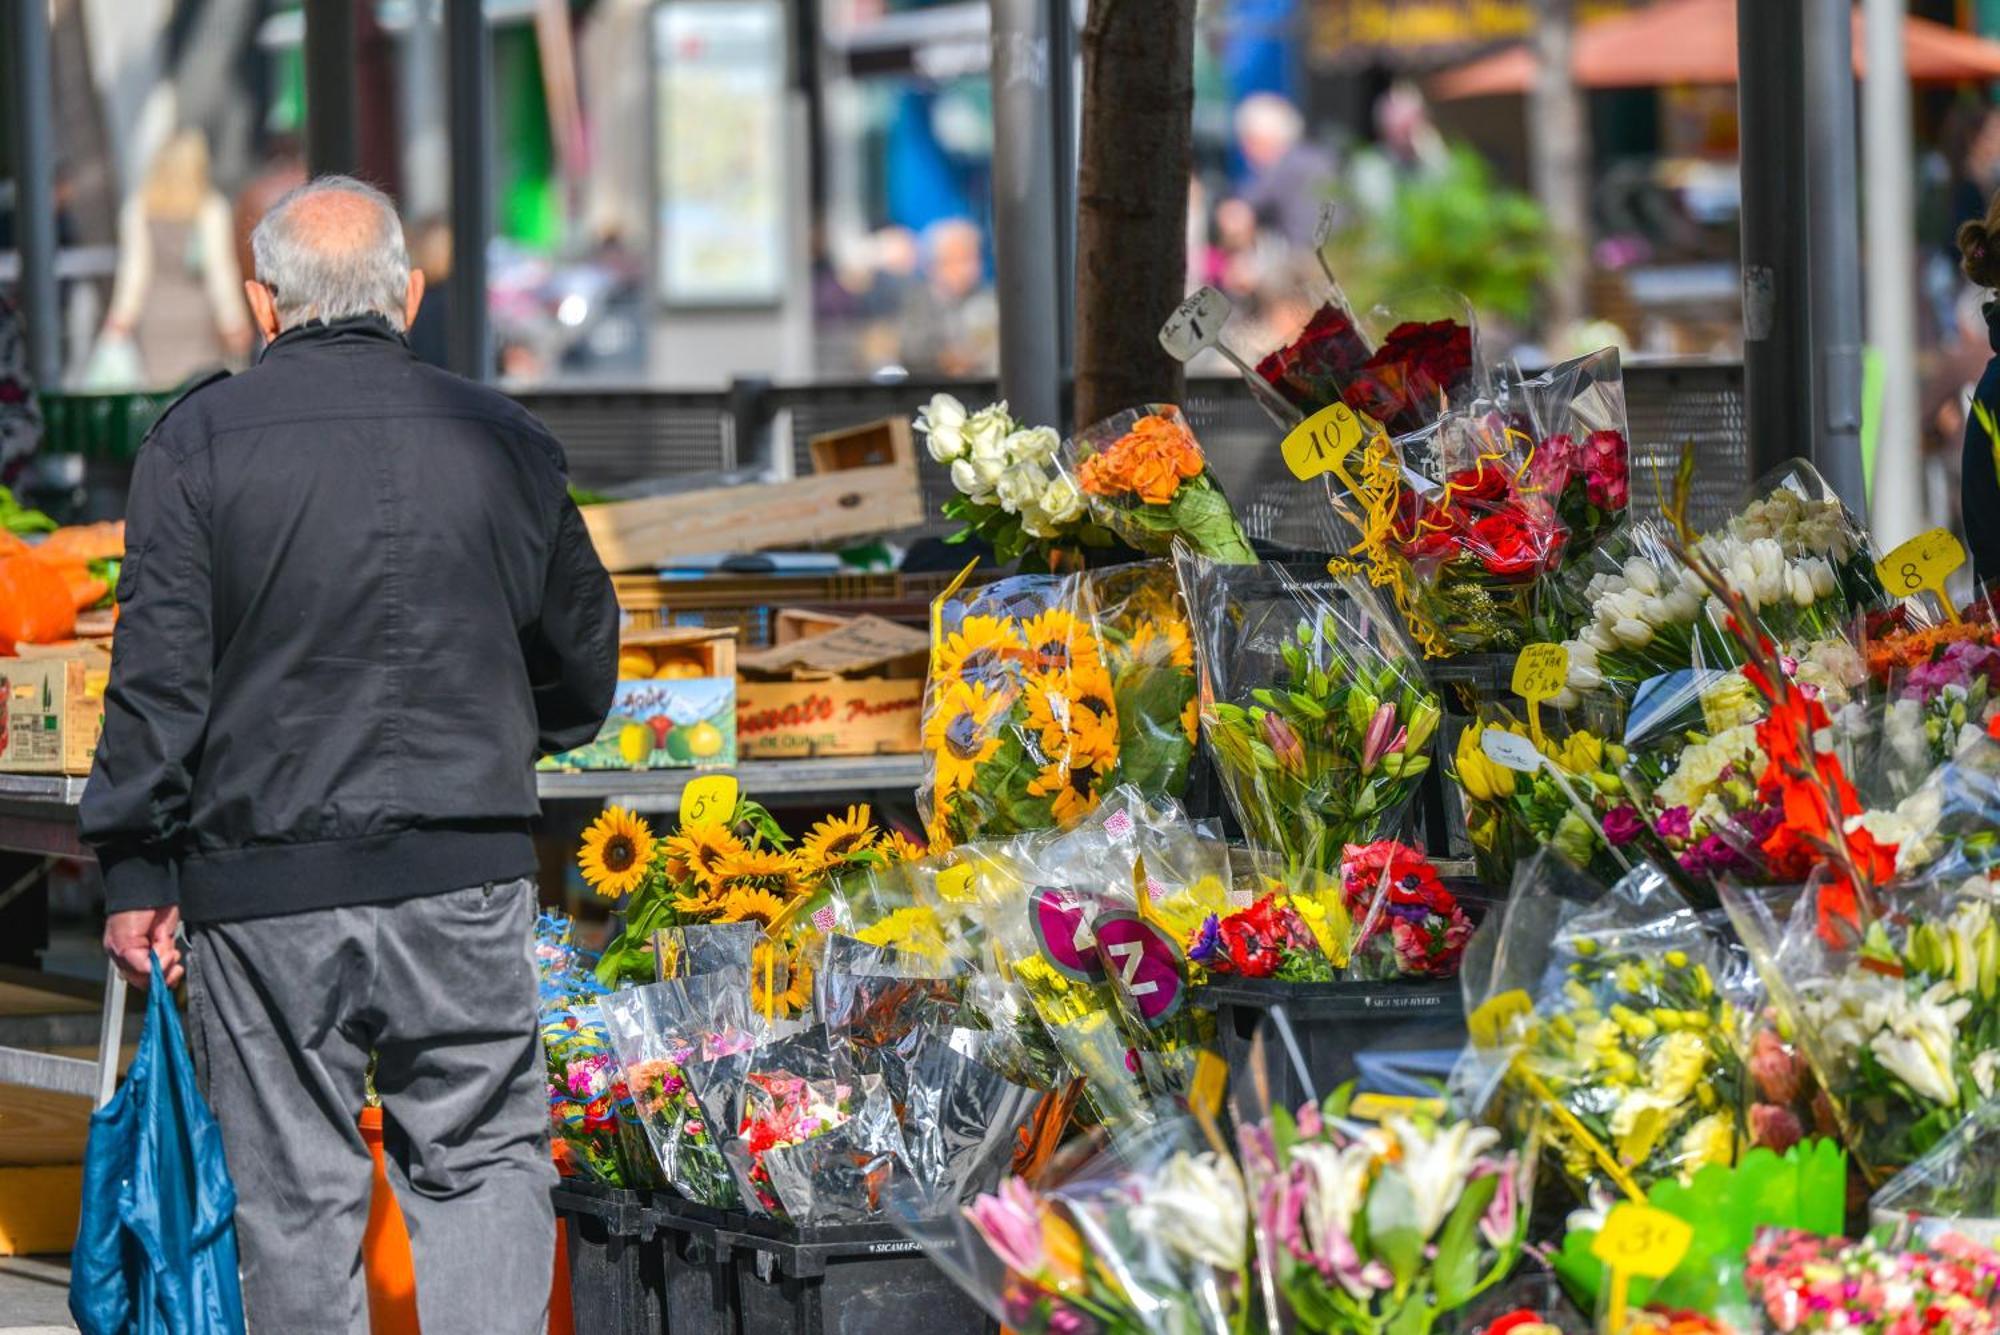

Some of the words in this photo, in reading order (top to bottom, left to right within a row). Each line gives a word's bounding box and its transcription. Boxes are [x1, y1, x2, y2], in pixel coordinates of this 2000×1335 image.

[1302, 408, 1349, 463] 10€
[1901, 548, 1931, 588] 8€
[690, 791, 720, 819] 5€
